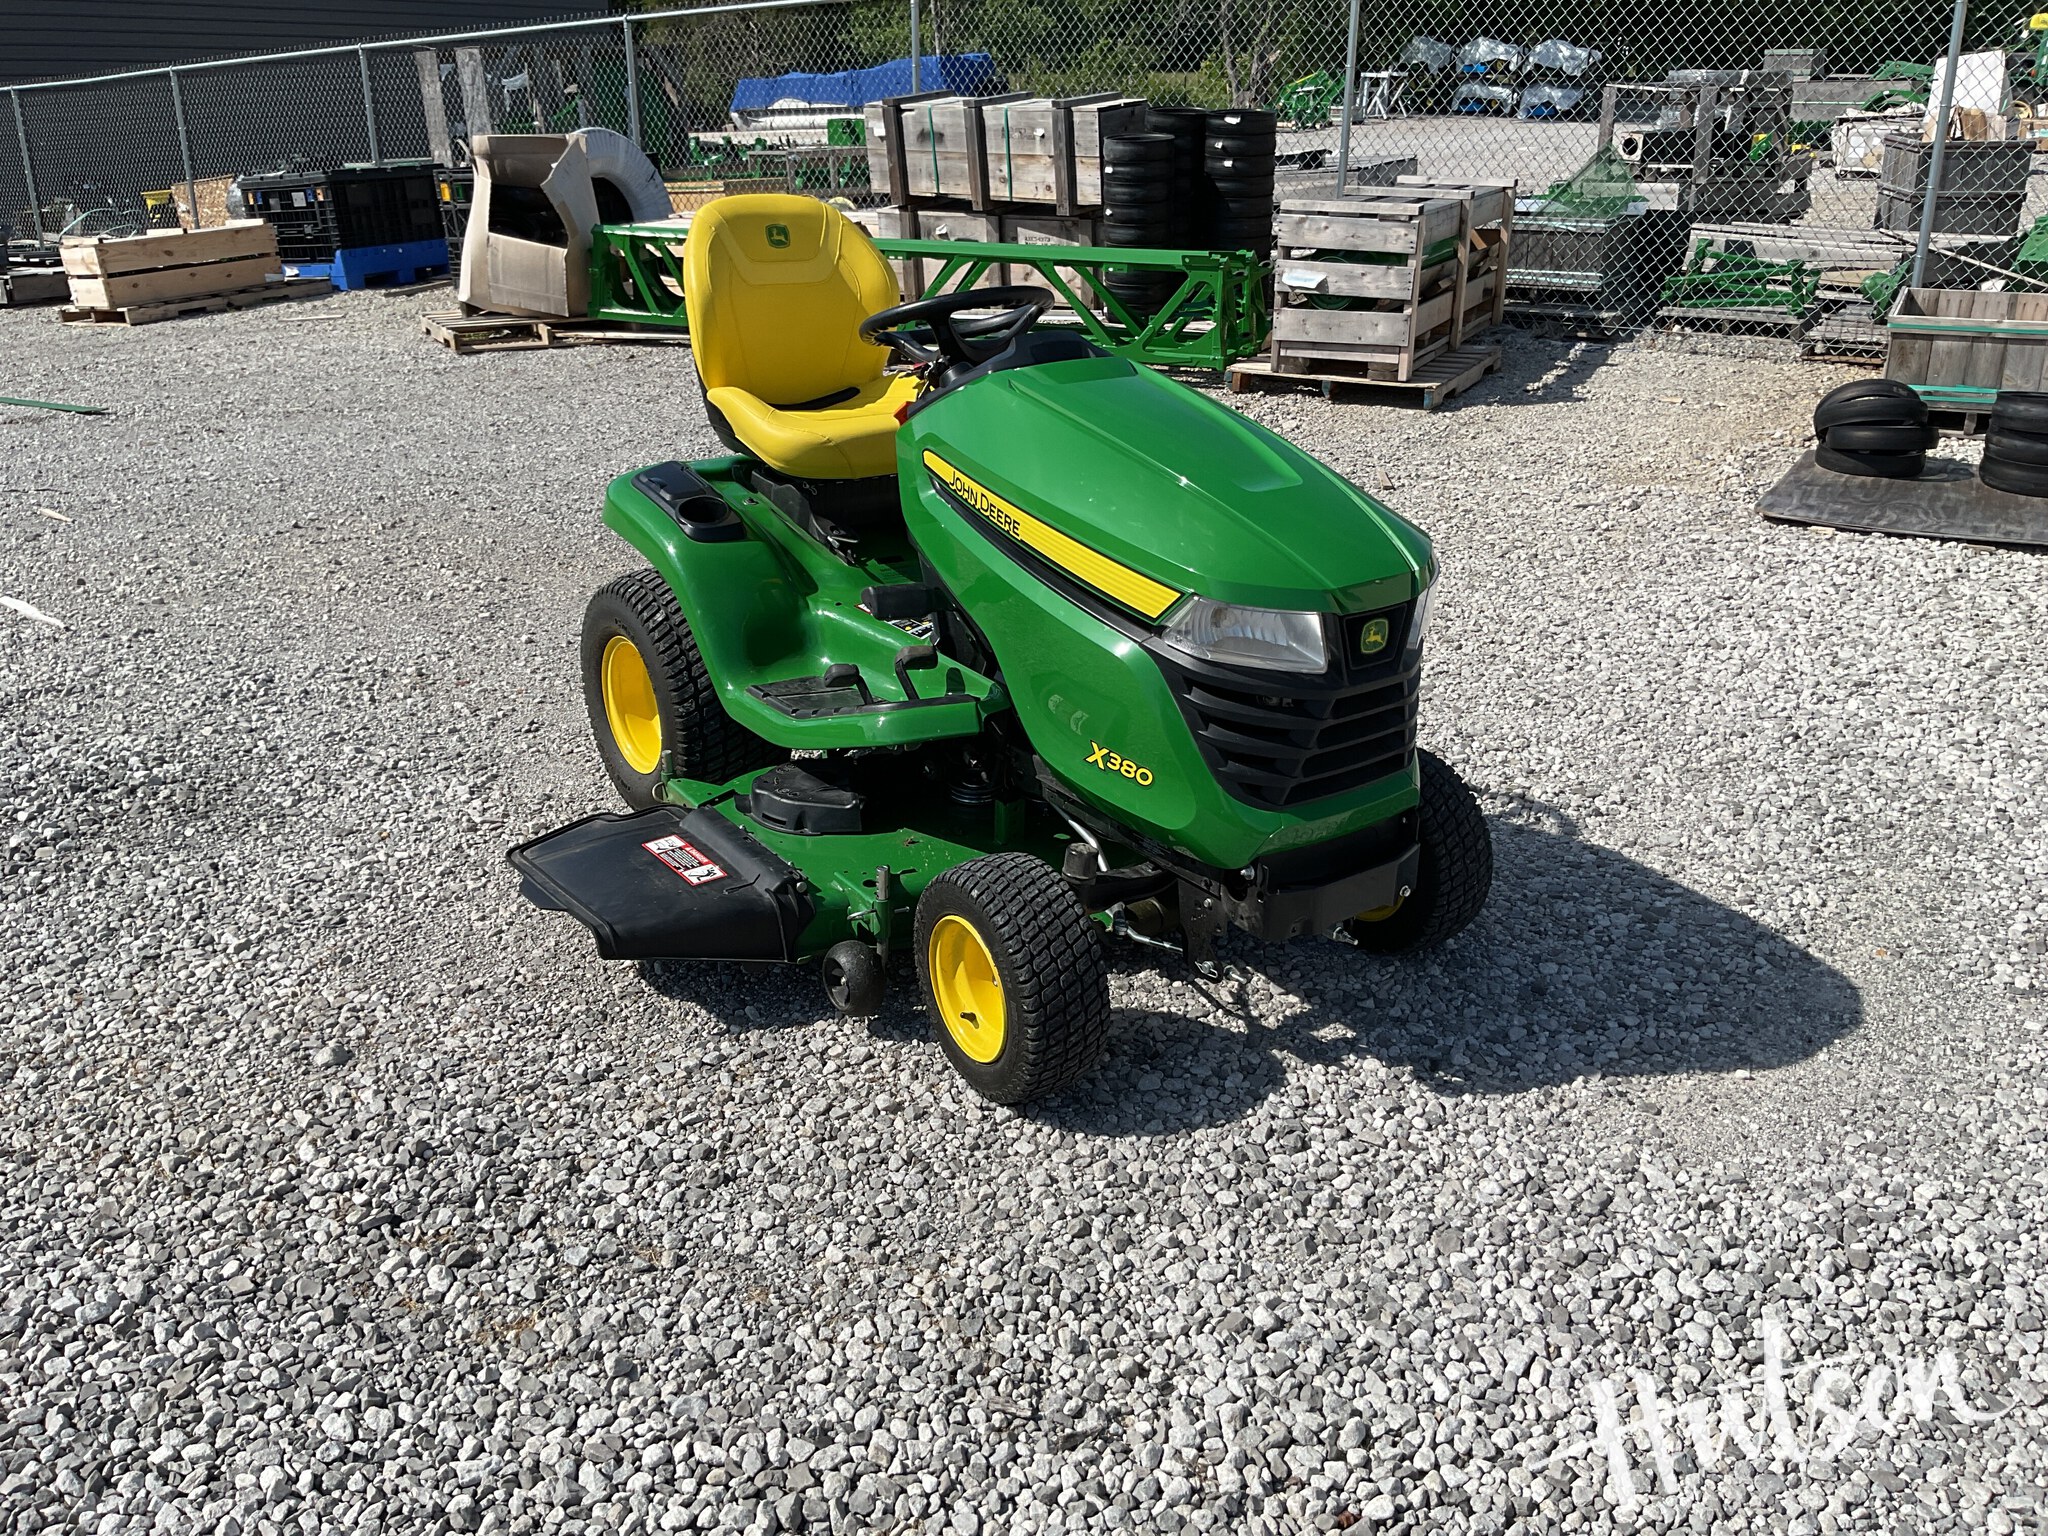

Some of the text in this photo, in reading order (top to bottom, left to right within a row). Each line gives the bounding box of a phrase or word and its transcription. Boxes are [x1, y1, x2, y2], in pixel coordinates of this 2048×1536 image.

[949, 470, 1021, 537] JOHN DEERE
[1083, 740, 1154, 787] X380
